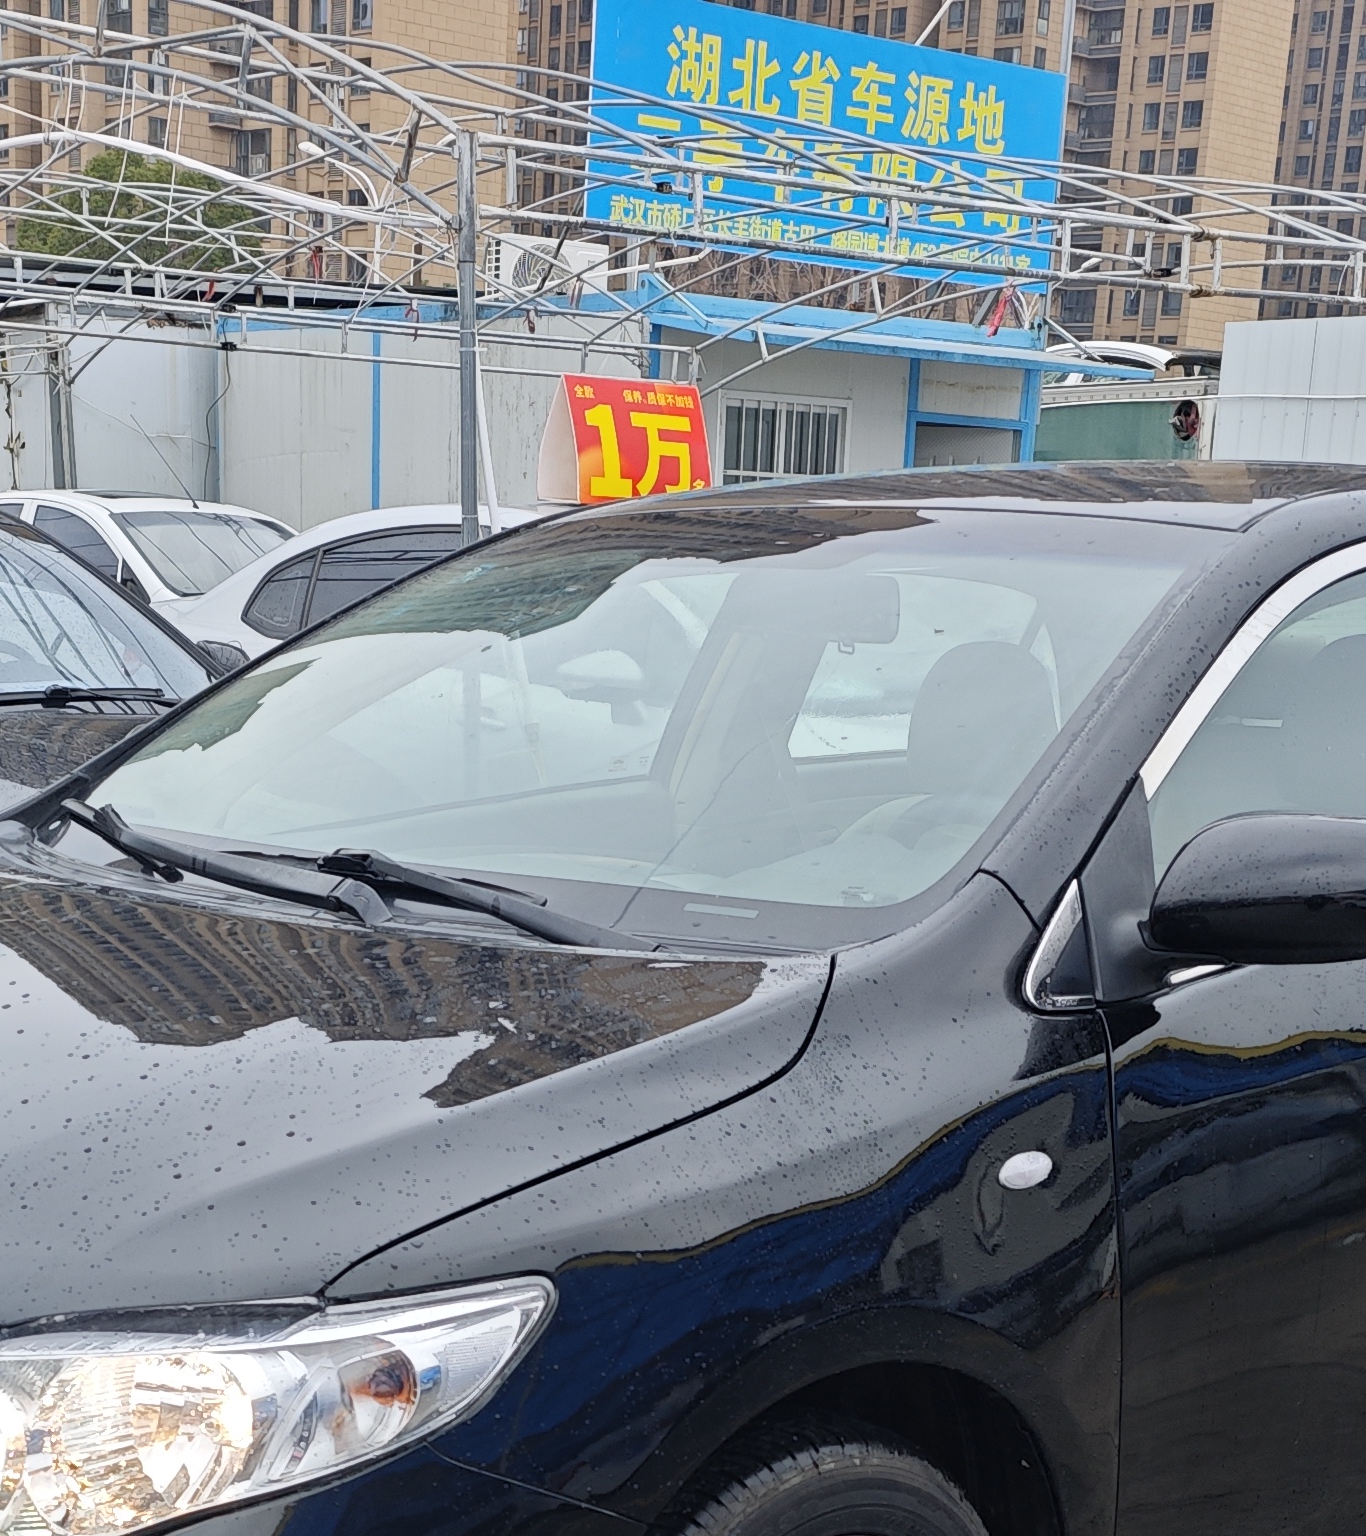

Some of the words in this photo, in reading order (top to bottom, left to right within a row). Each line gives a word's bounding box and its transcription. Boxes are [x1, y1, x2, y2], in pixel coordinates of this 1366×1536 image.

[666, 24, 1006, 156] 湖北省车源地
[584, 403, 692, 498] 1万
